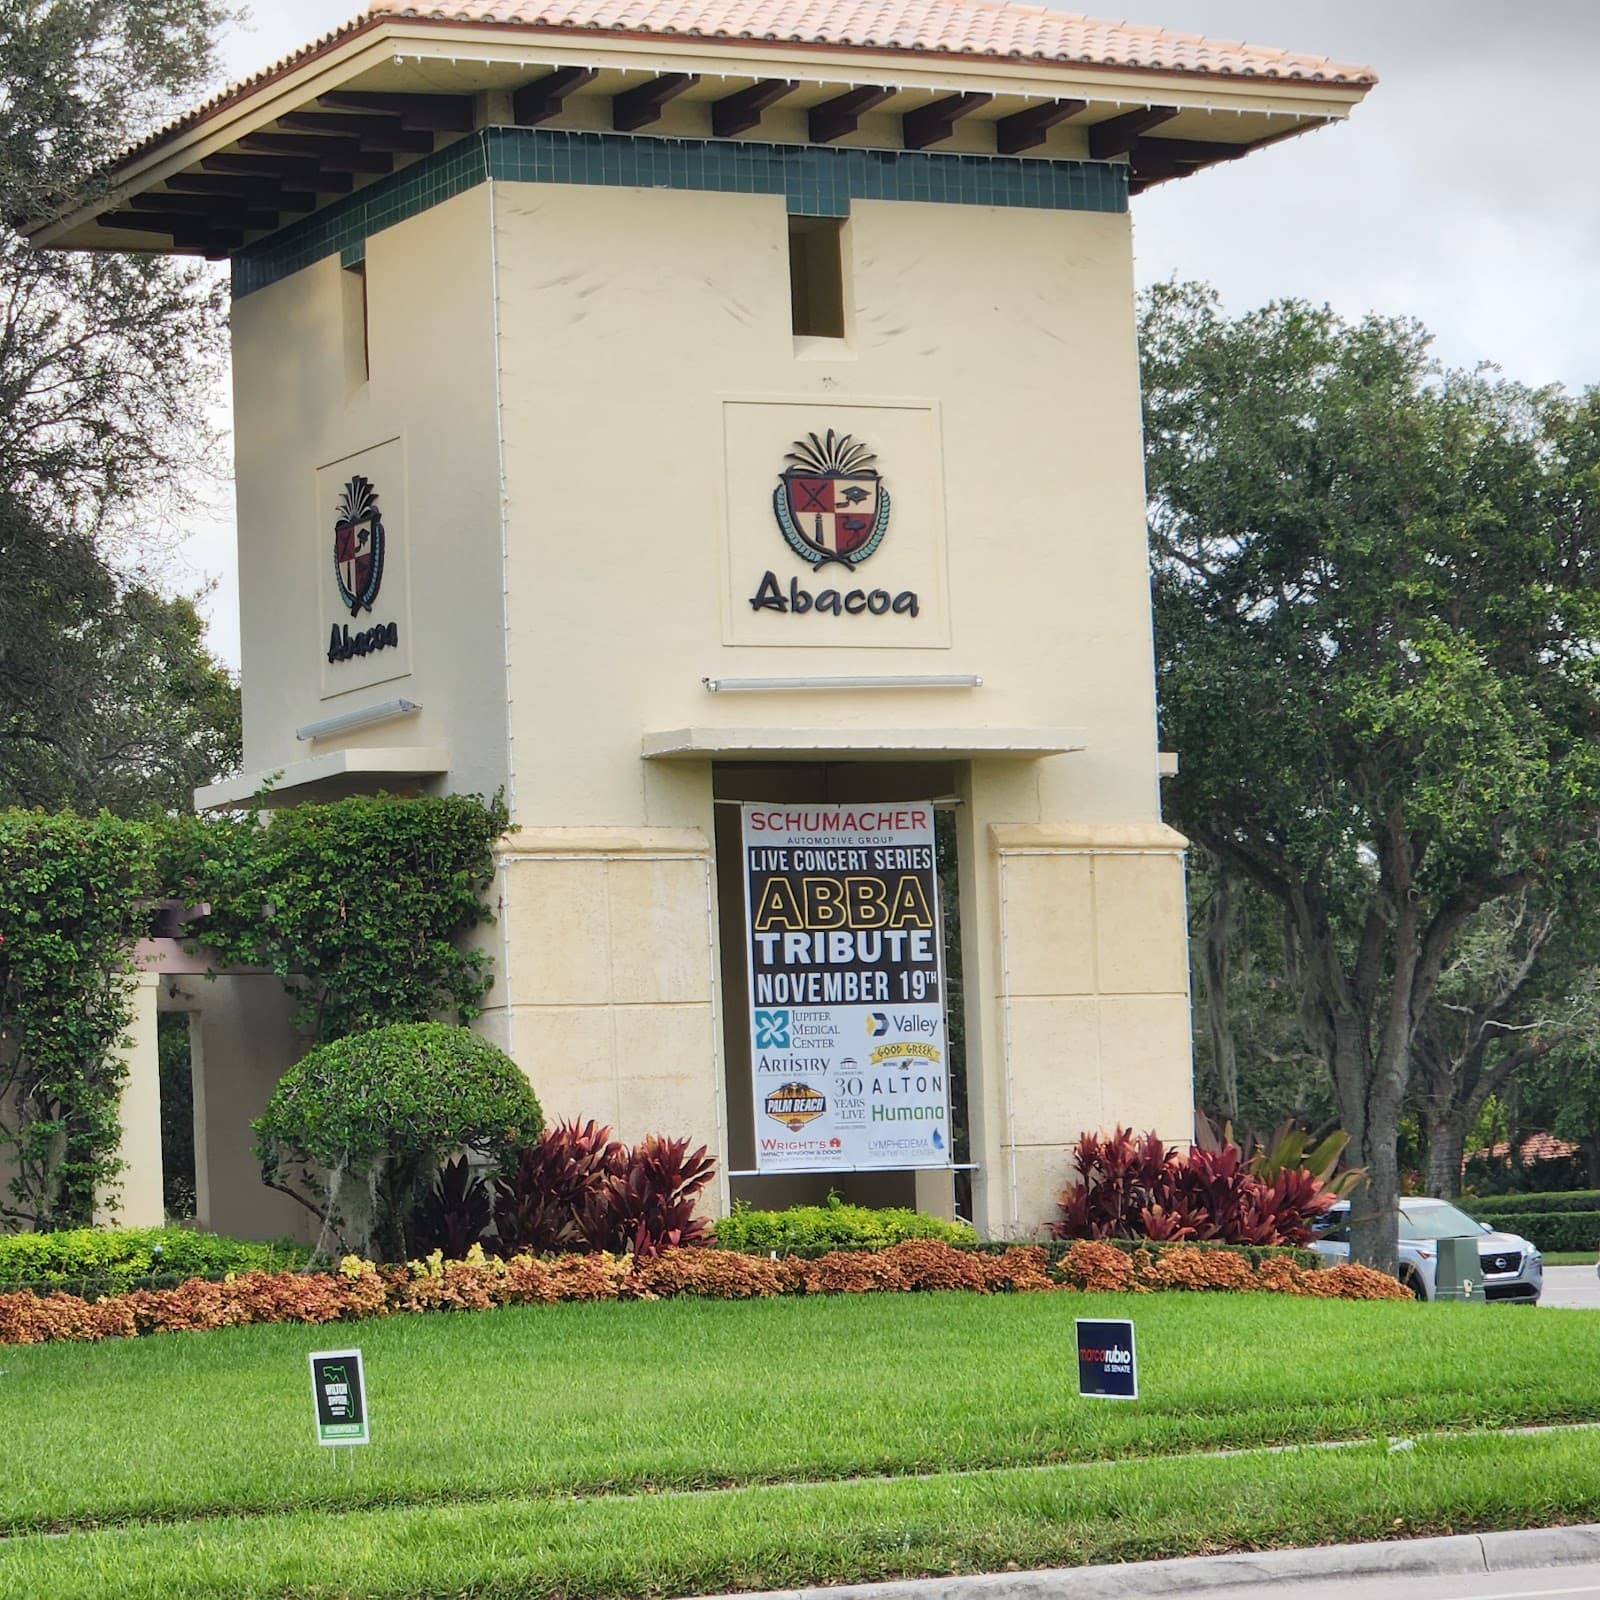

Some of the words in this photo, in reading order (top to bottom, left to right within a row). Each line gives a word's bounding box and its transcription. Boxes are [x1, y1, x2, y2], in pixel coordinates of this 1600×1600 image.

[749, 570, 920, 617] Abacoa
[327, 622, 398, 664] Abacoa
[751, 811, 927, 831] SCHUMACHER
[787, 836, 853, 845] AUTOMOTIVE
[858, 836, 894, 844] GROUP
[751, 850, 789, 871] LIVE
[793, 850, 868, 871] CONCERT
[875, 848, 931, 870] SERIES
[755, 876, 933, 930] ABBA
[755, 930, 933, 965] TRIBUTE
[758, 971, 889, 1004] NOVEMBER
[792, 1010, 831, 1022] JUPITER
[792, 1024, 840, 1035] MEDICAL
[893, 1014, 938, 1037] Valley
[792, 1037, 835, 1049] CENTER
[877, 1045, 902, 1057] GOOD
[906, 1044, 933, 1056] GREEK
[834, 1077, 863, 1097] 30
[872, 1075, 942, 1094] ALTON
[768, 1099, 793, 1113] PALM
[793, 1098, 824, 1112] BEACH
[834, 1099, 865, 1109] YEARS
[872, 1104, 944, 1122] Humana
[841, 1109, 865, 1120] LIVE
[761, 1139, 826, 1151] WRIGHT'S
